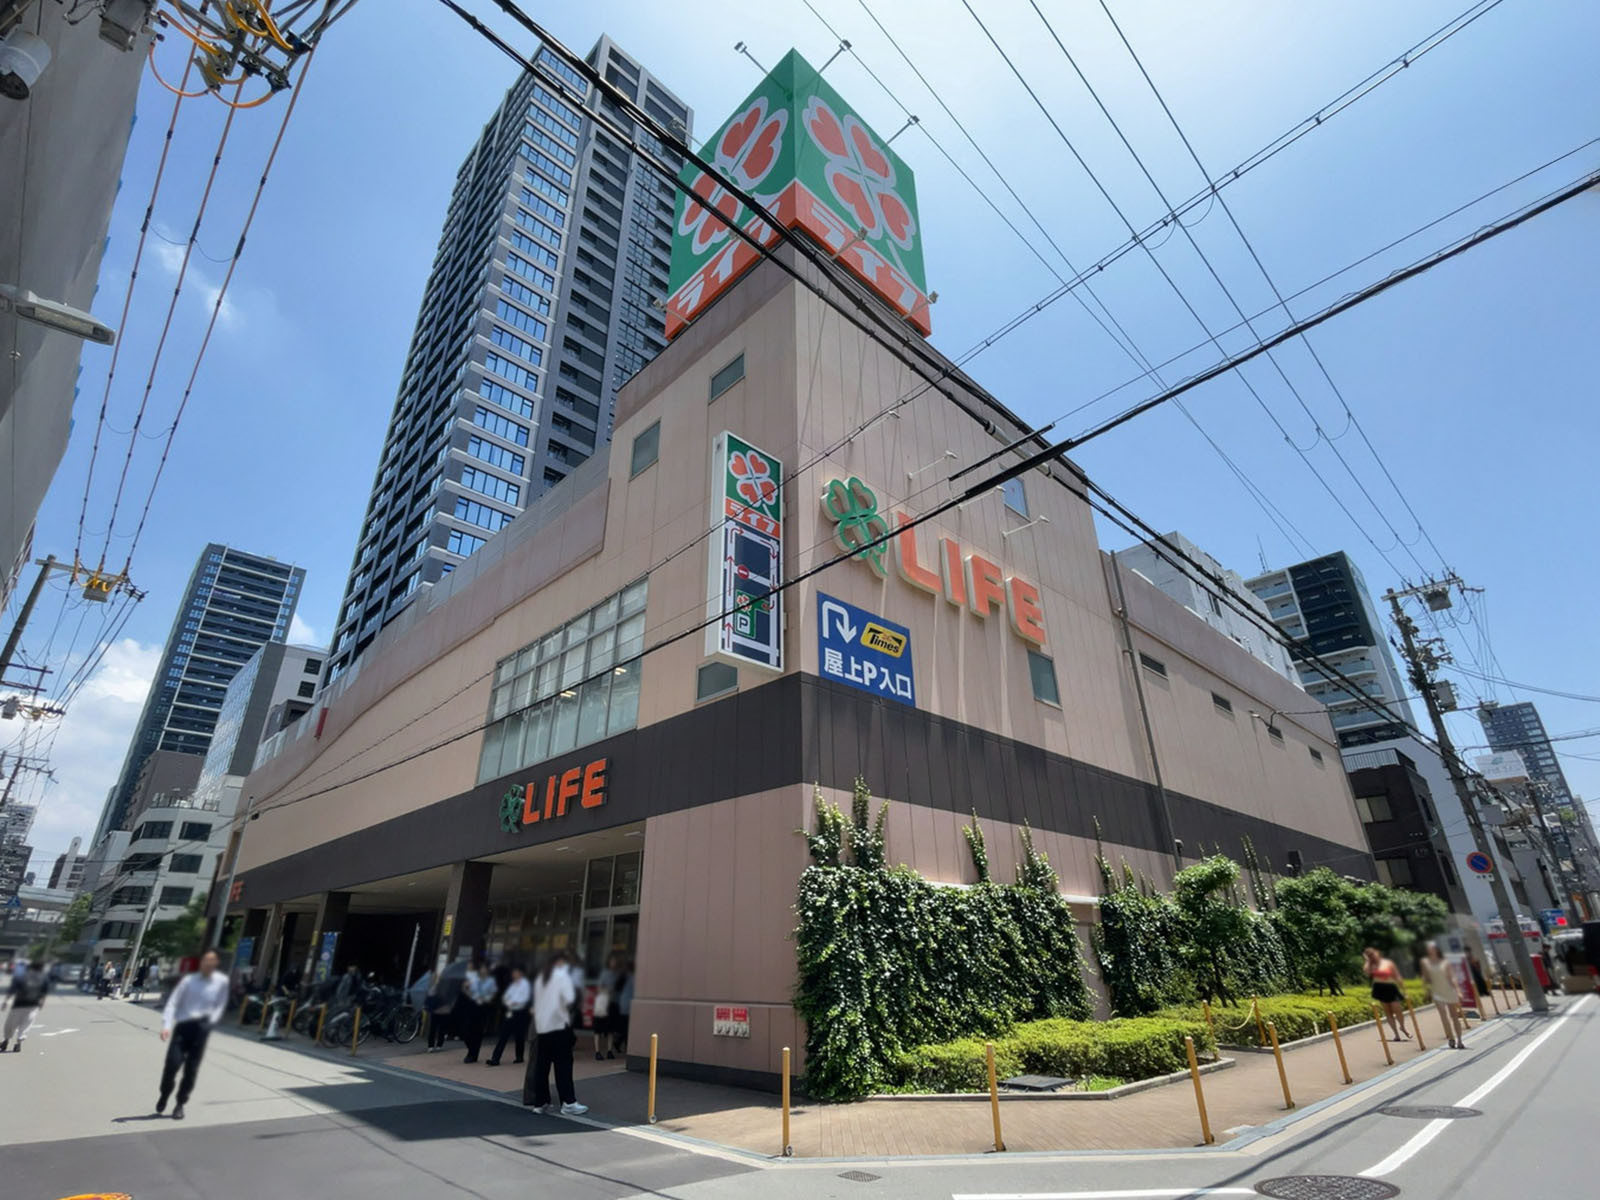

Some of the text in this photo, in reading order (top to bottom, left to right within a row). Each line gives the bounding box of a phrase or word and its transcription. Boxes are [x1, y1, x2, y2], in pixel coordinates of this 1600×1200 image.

[677, 200, 781, 315] ライフ
[811, 202, 918, 312] ライフ
[729, 502, 776, 534] ライフ
[892, 511, 1048, 646] LIFE
[739, 617, 749, 629] P
[867, 627, 903, 654] Times
[824, 647, 913, 700] 屋上P入口
[522, 758, 607, 825] LIFE
